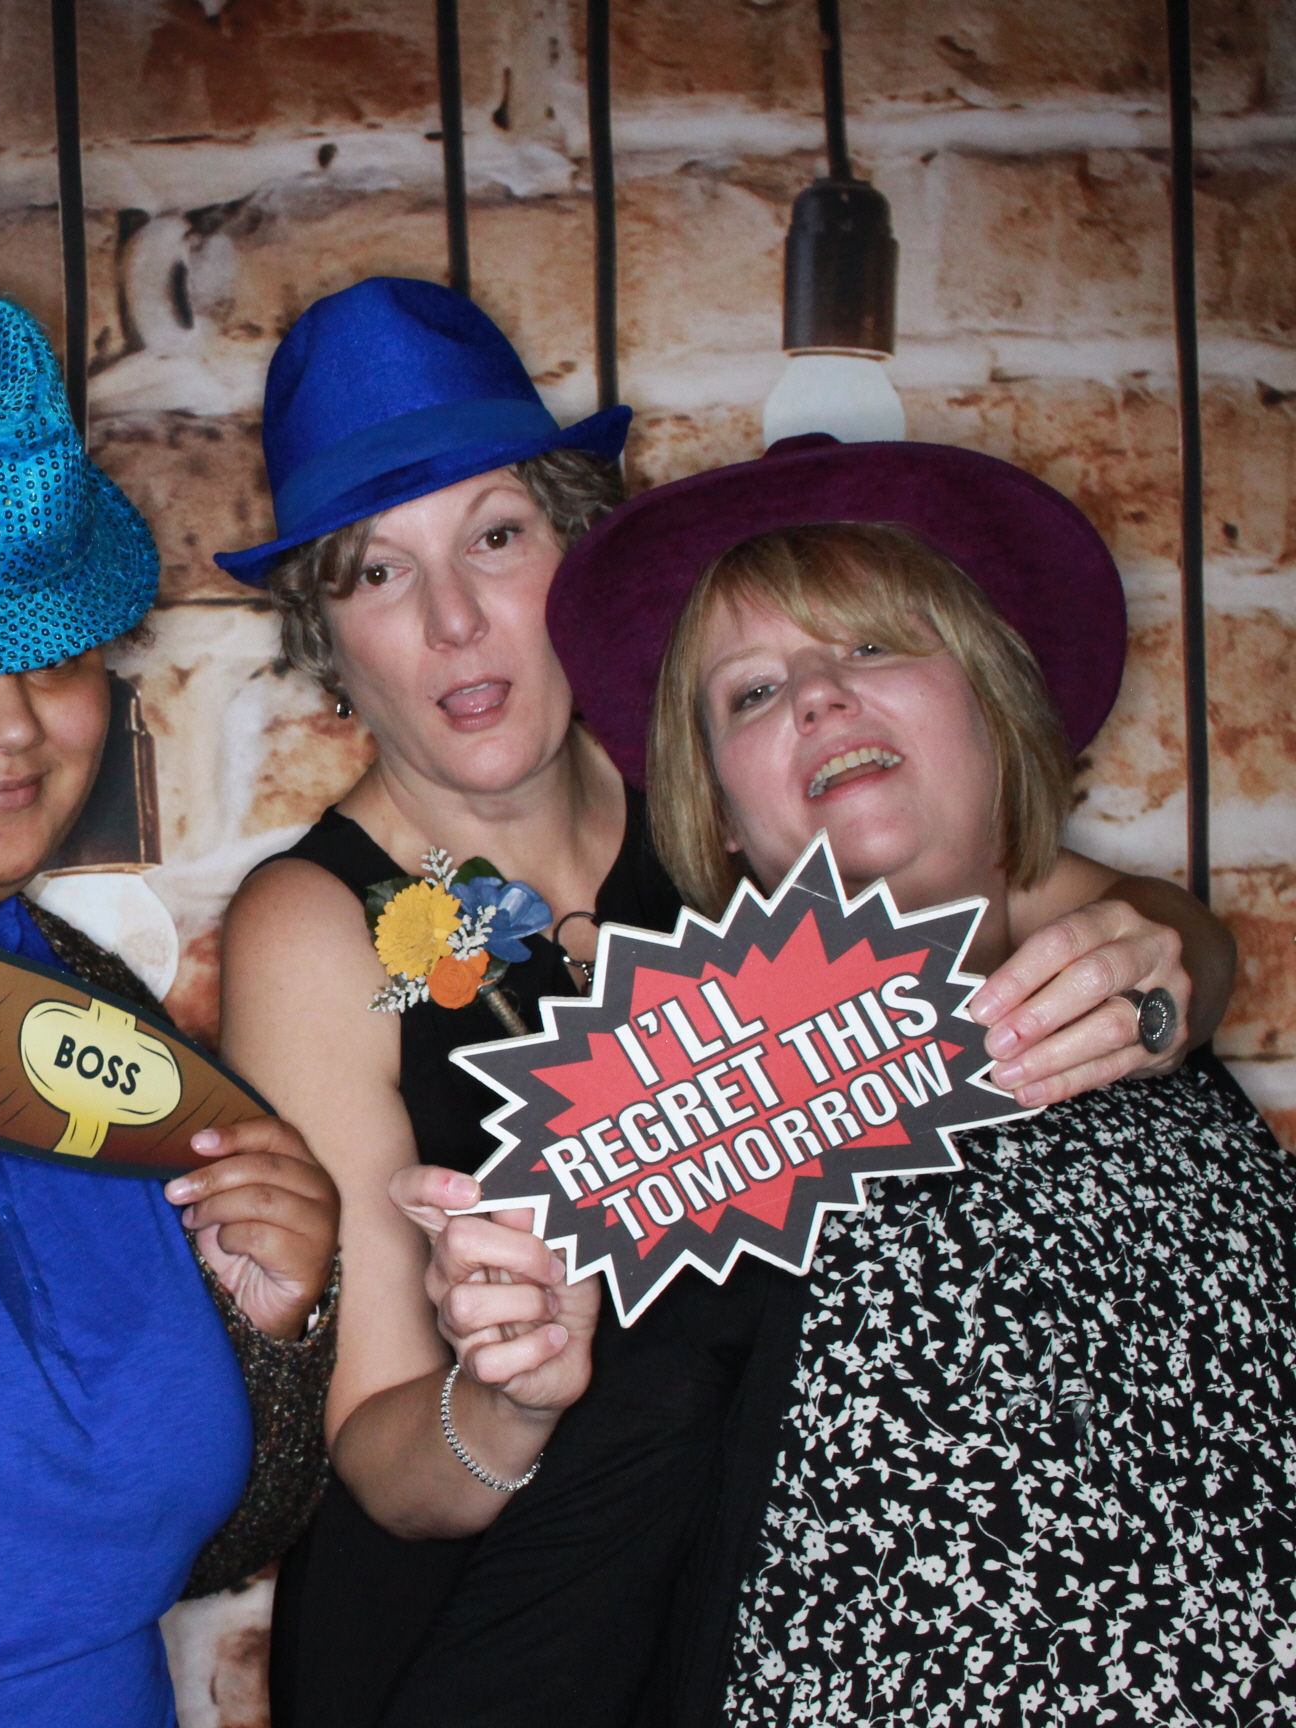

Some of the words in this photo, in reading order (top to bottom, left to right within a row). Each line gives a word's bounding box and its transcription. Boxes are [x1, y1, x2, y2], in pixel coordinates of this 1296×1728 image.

[54, 1034, 141, 1095] BOSS
[540, 1045, 780, 1201] REGRET
[779, 974, 938, 1084] THIS
[614, 979, 764, 1088] I'LL
[603, 1042, 953, 1241] TOMORROW
